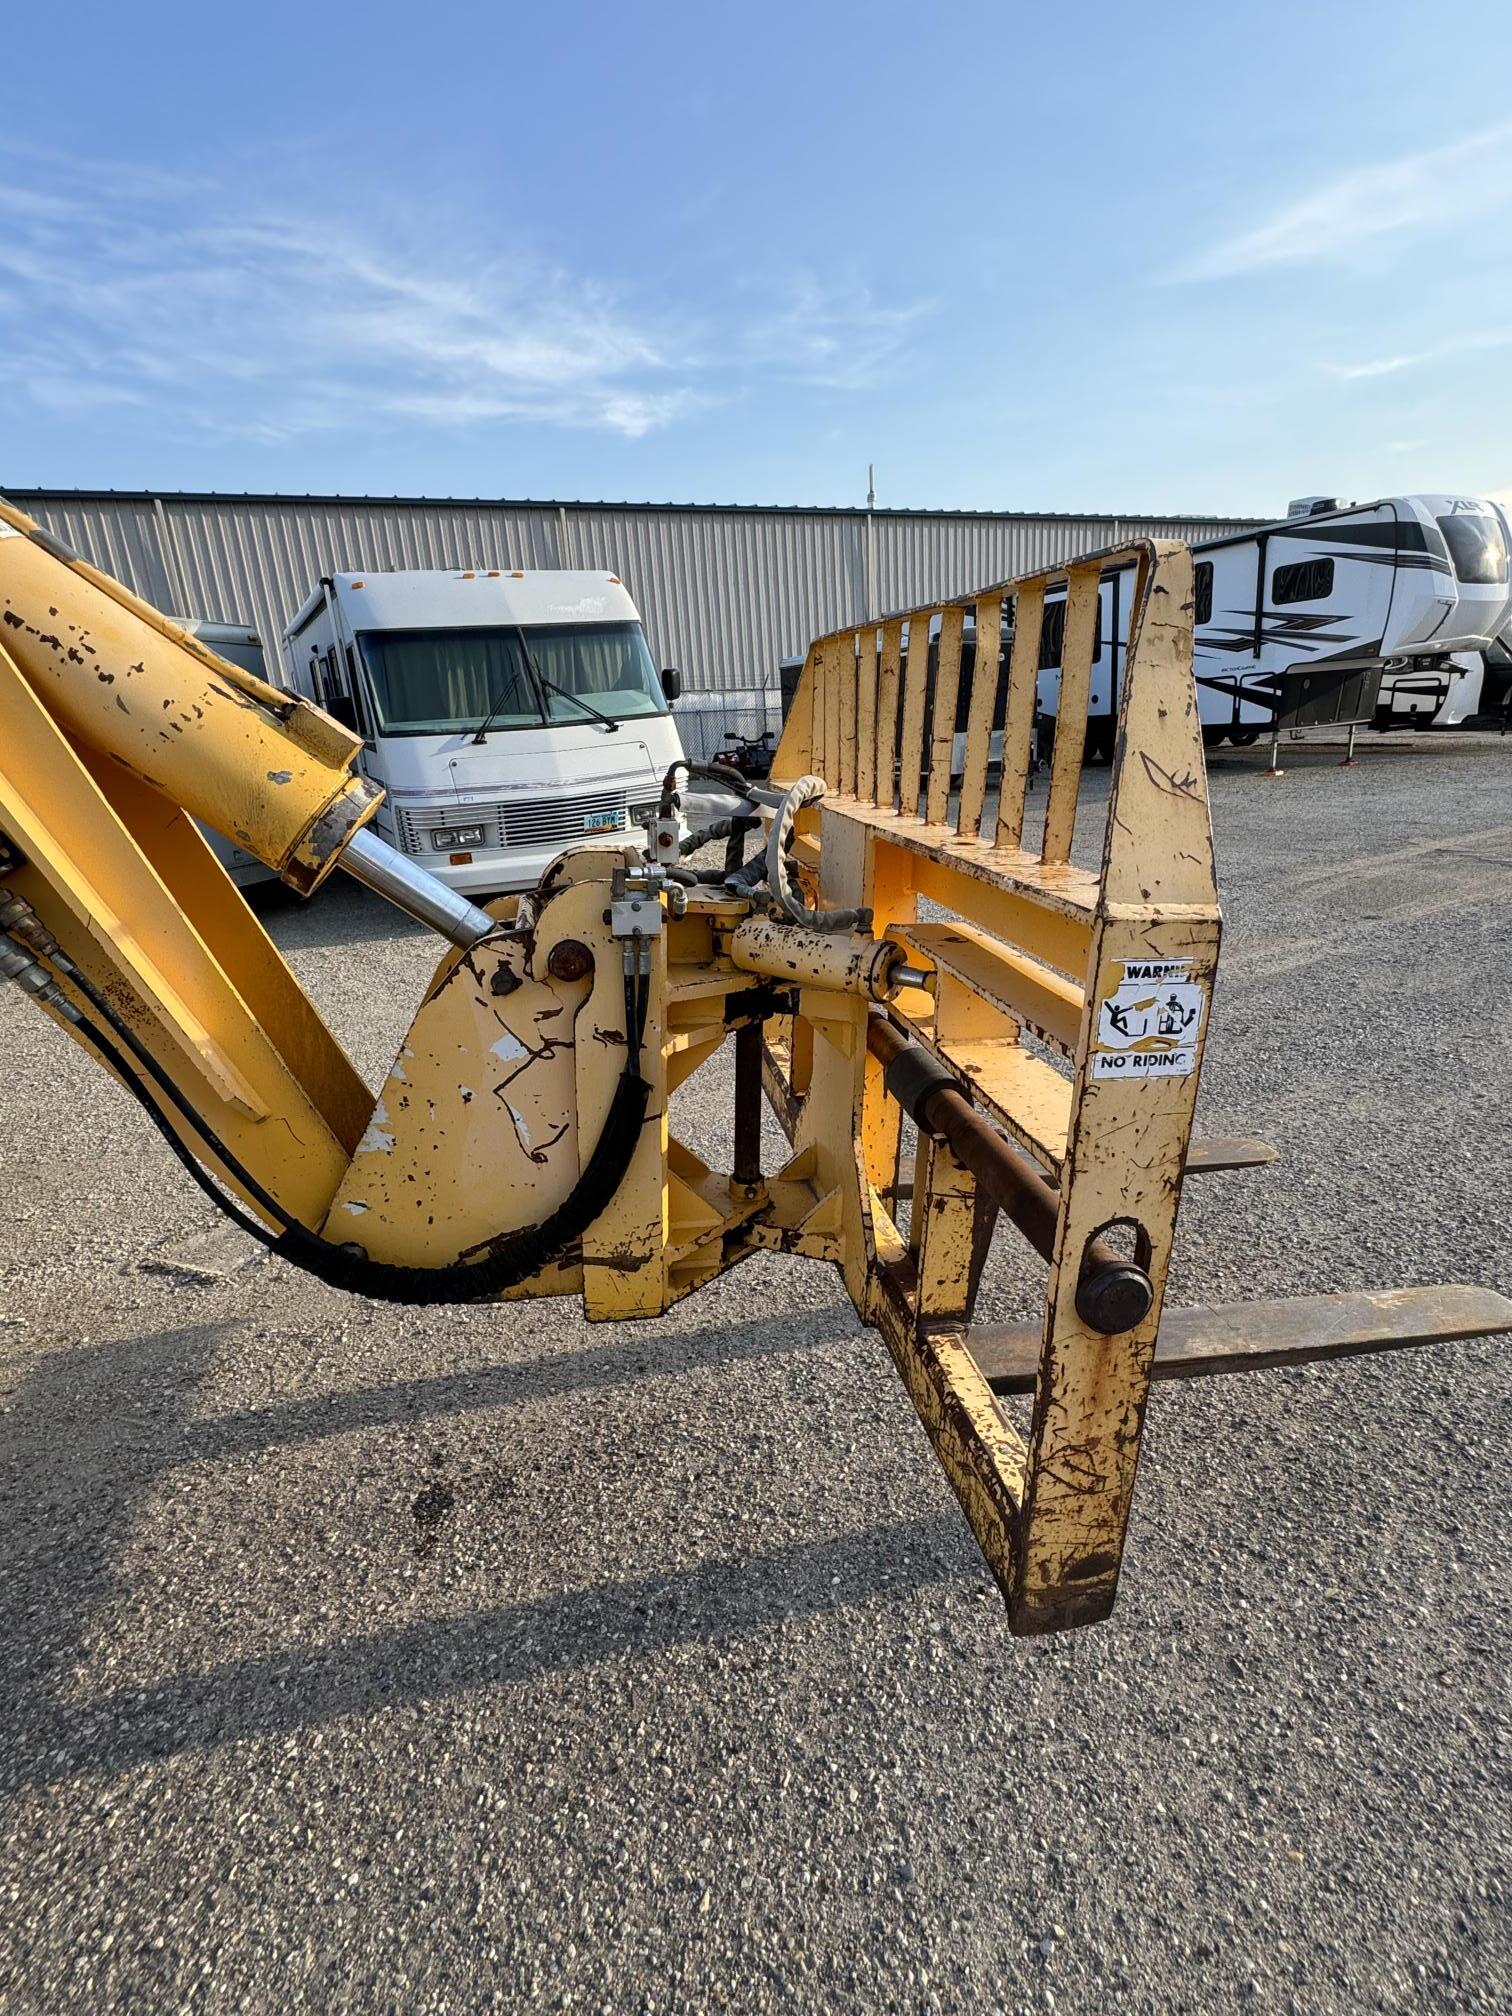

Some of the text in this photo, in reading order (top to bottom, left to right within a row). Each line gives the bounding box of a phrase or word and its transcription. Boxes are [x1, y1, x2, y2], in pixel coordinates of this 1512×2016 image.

[1127, 965, 1186, 979] WARN
[1101, 1053, 1187, 1069] NO RIDING
